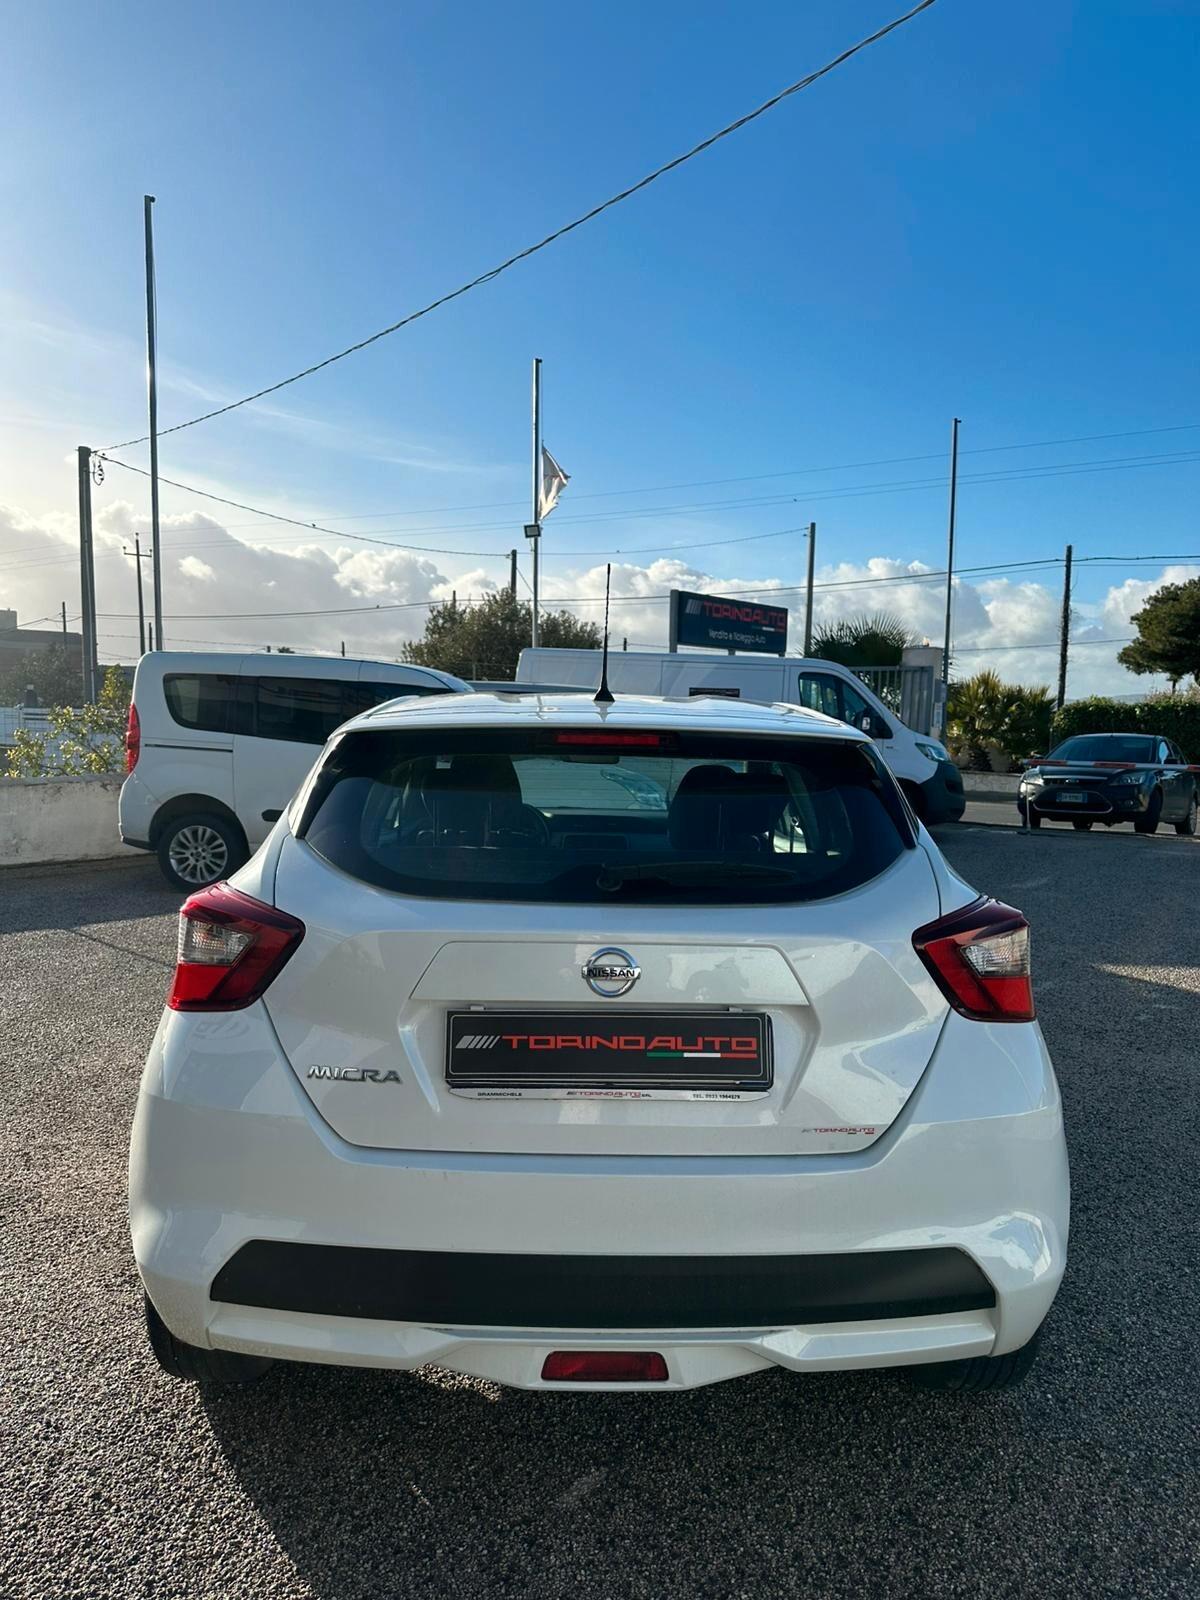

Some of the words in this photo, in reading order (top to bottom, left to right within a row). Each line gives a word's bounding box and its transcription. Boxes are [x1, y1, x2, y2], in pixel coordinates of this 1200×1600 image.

[703, 600, 786, 627] TORINOAUTO
[588, 966, 635, 978] NISSAN
[502, 1035, 758, 1050] TORINOAUTO
[306, 1064, 403, 1085] MICRA
